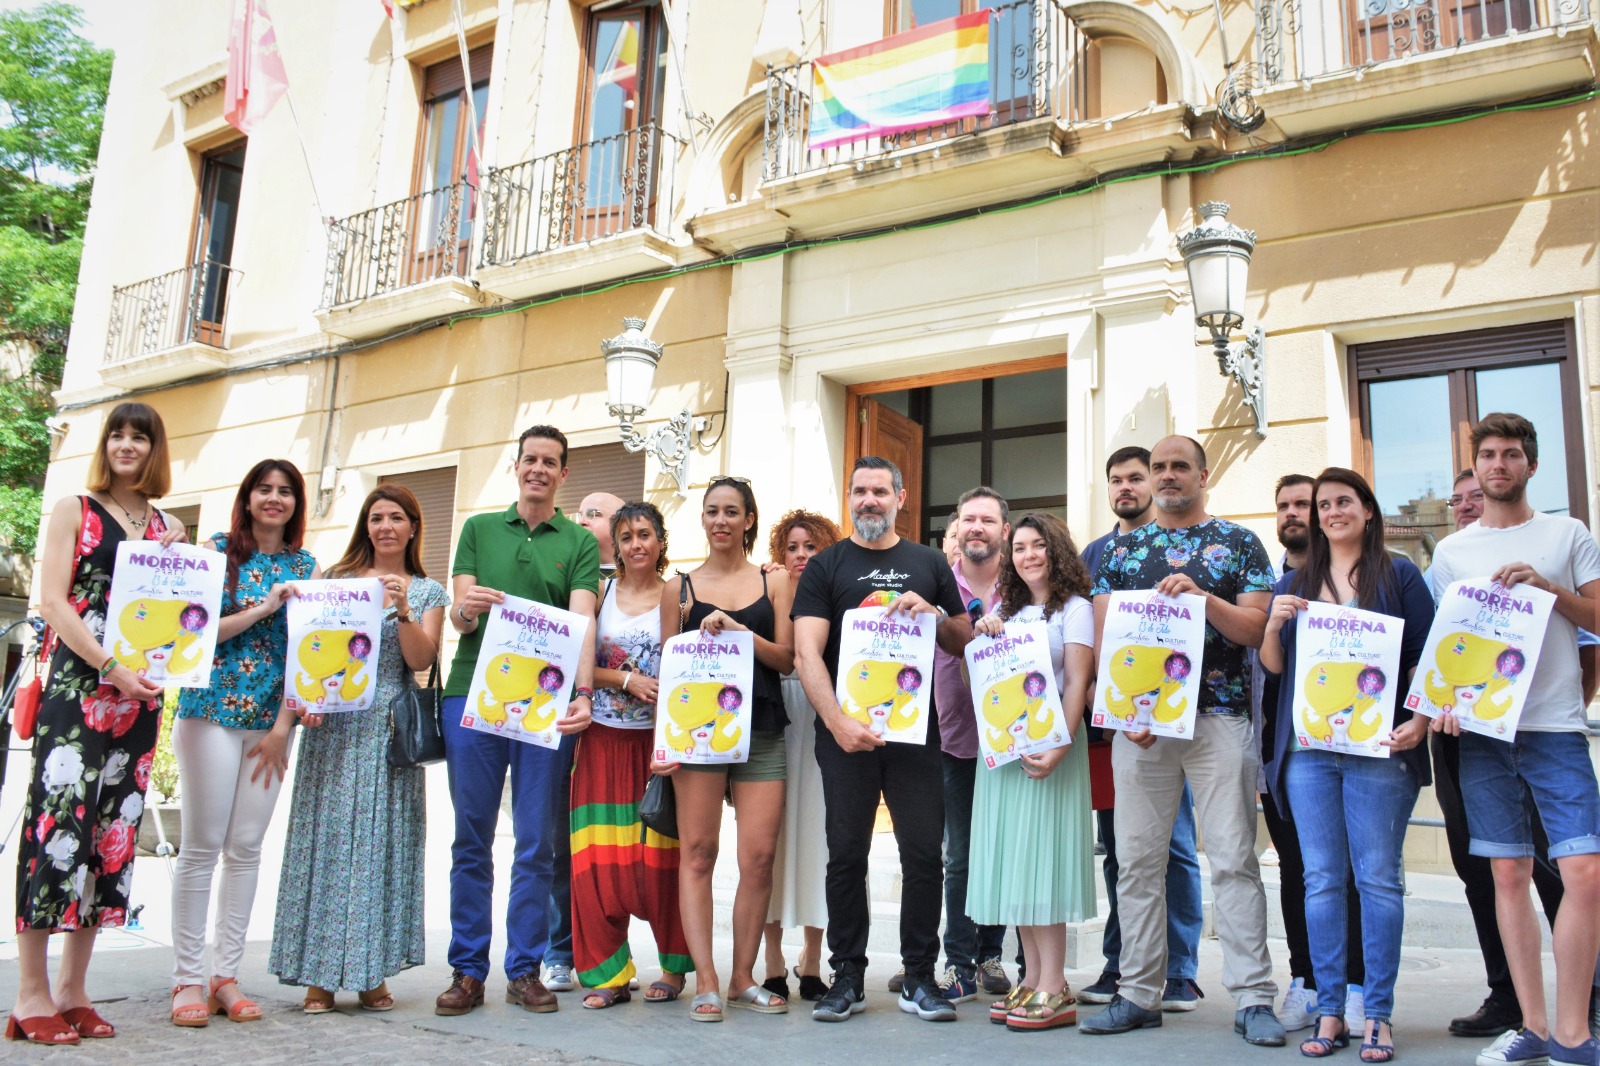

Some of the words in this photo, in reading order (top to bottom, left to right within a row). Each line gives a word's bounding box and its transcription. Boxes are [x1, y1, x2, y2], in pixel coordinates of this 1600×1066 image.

[130, 553, 209, 571] MORENA
[300, 591, 370, 602] MORENA
[1458, 585, 1534, 615] MORENA
[1118, 602, 1192, 620] MORENA
[500, 608, 570, 637] MORENA
[852, 620, 922, 636] MORENA
[1308, 617, 1386, 633] MORENA
[1502, 632, 1524, 640] CULTURE
[542, 650, 562, 659] CULTURE
[672, 643, 740, 655] MORENA
[974, 634, 1034, 663] MORENA
